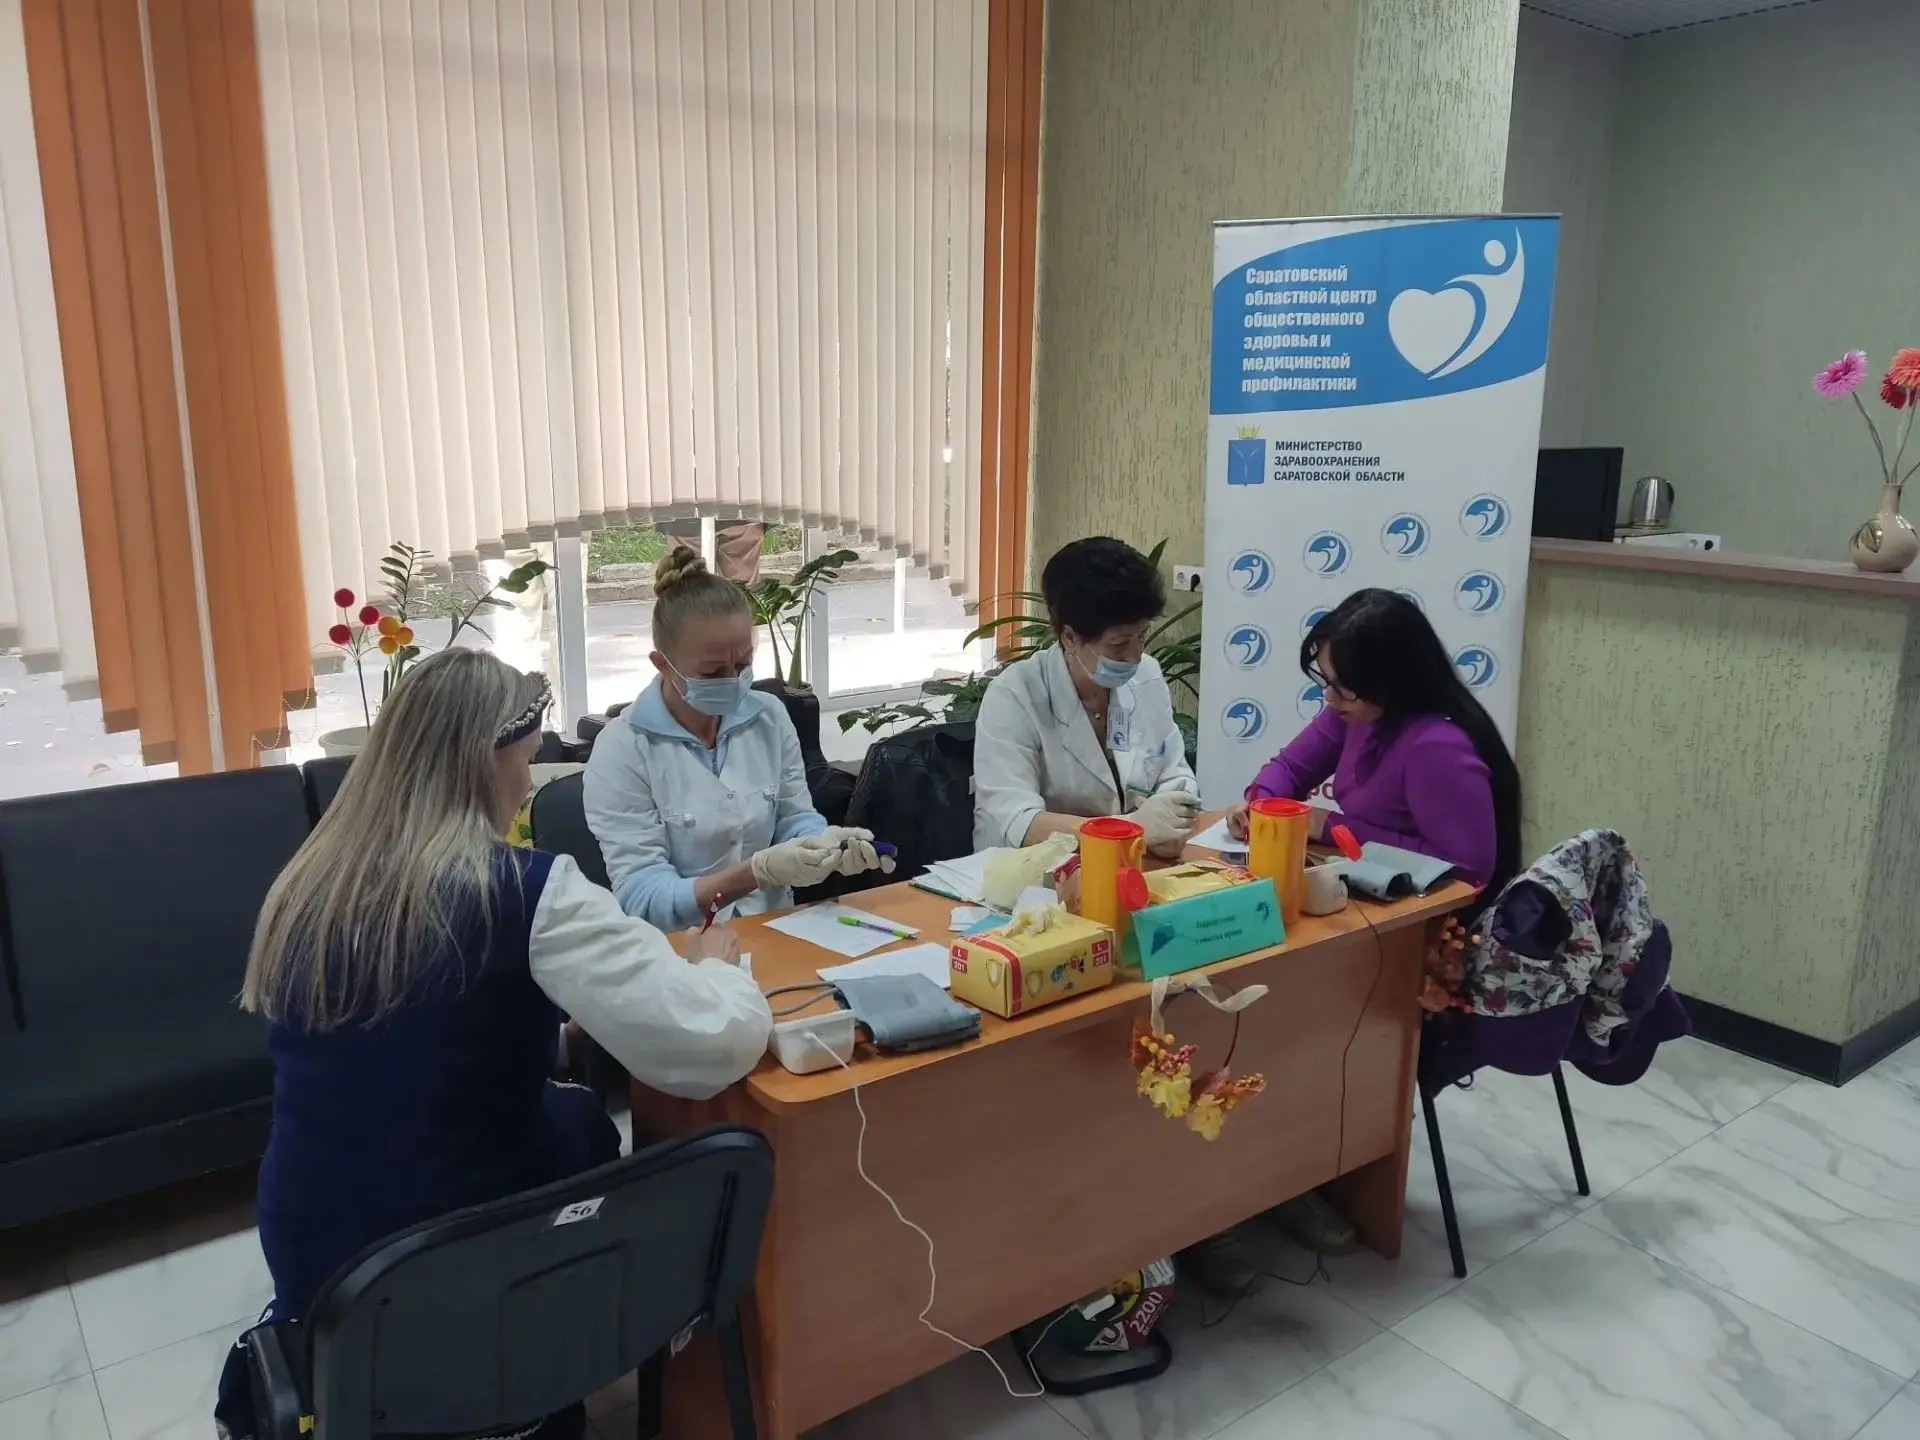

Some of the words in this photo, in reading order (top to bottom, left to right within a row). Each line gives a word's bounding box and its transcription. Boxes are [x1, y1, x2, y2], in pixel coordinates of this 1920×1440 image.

[1246, 265, 1348, 285] Саратовский
[1245, 287, 1328, 306] областной
[1330, 289, 1378, 306] центр
[1244, 311, 1365, 329] общественного
[1243, 334, 1318, 351] здоровья
[1320, 333, 1332, 348] и
[1242, 352, 1351, 372] медицинской
[1241, 376, 1358, 394] профилактики
[1275, 441, 1363, 452] МИНИСТЕРСТВО
[1274, 456, 1381, 467] ЗДРАВООХРАНЕНИЯ
[1274, 469, 1351, 481] САРАТОВСКОЙ
[1355, 471, 1405, 481] ОБЛАСТИ
[957, 948, 963, 958] L
[1129, 1291, 1164, 1333] 2200
